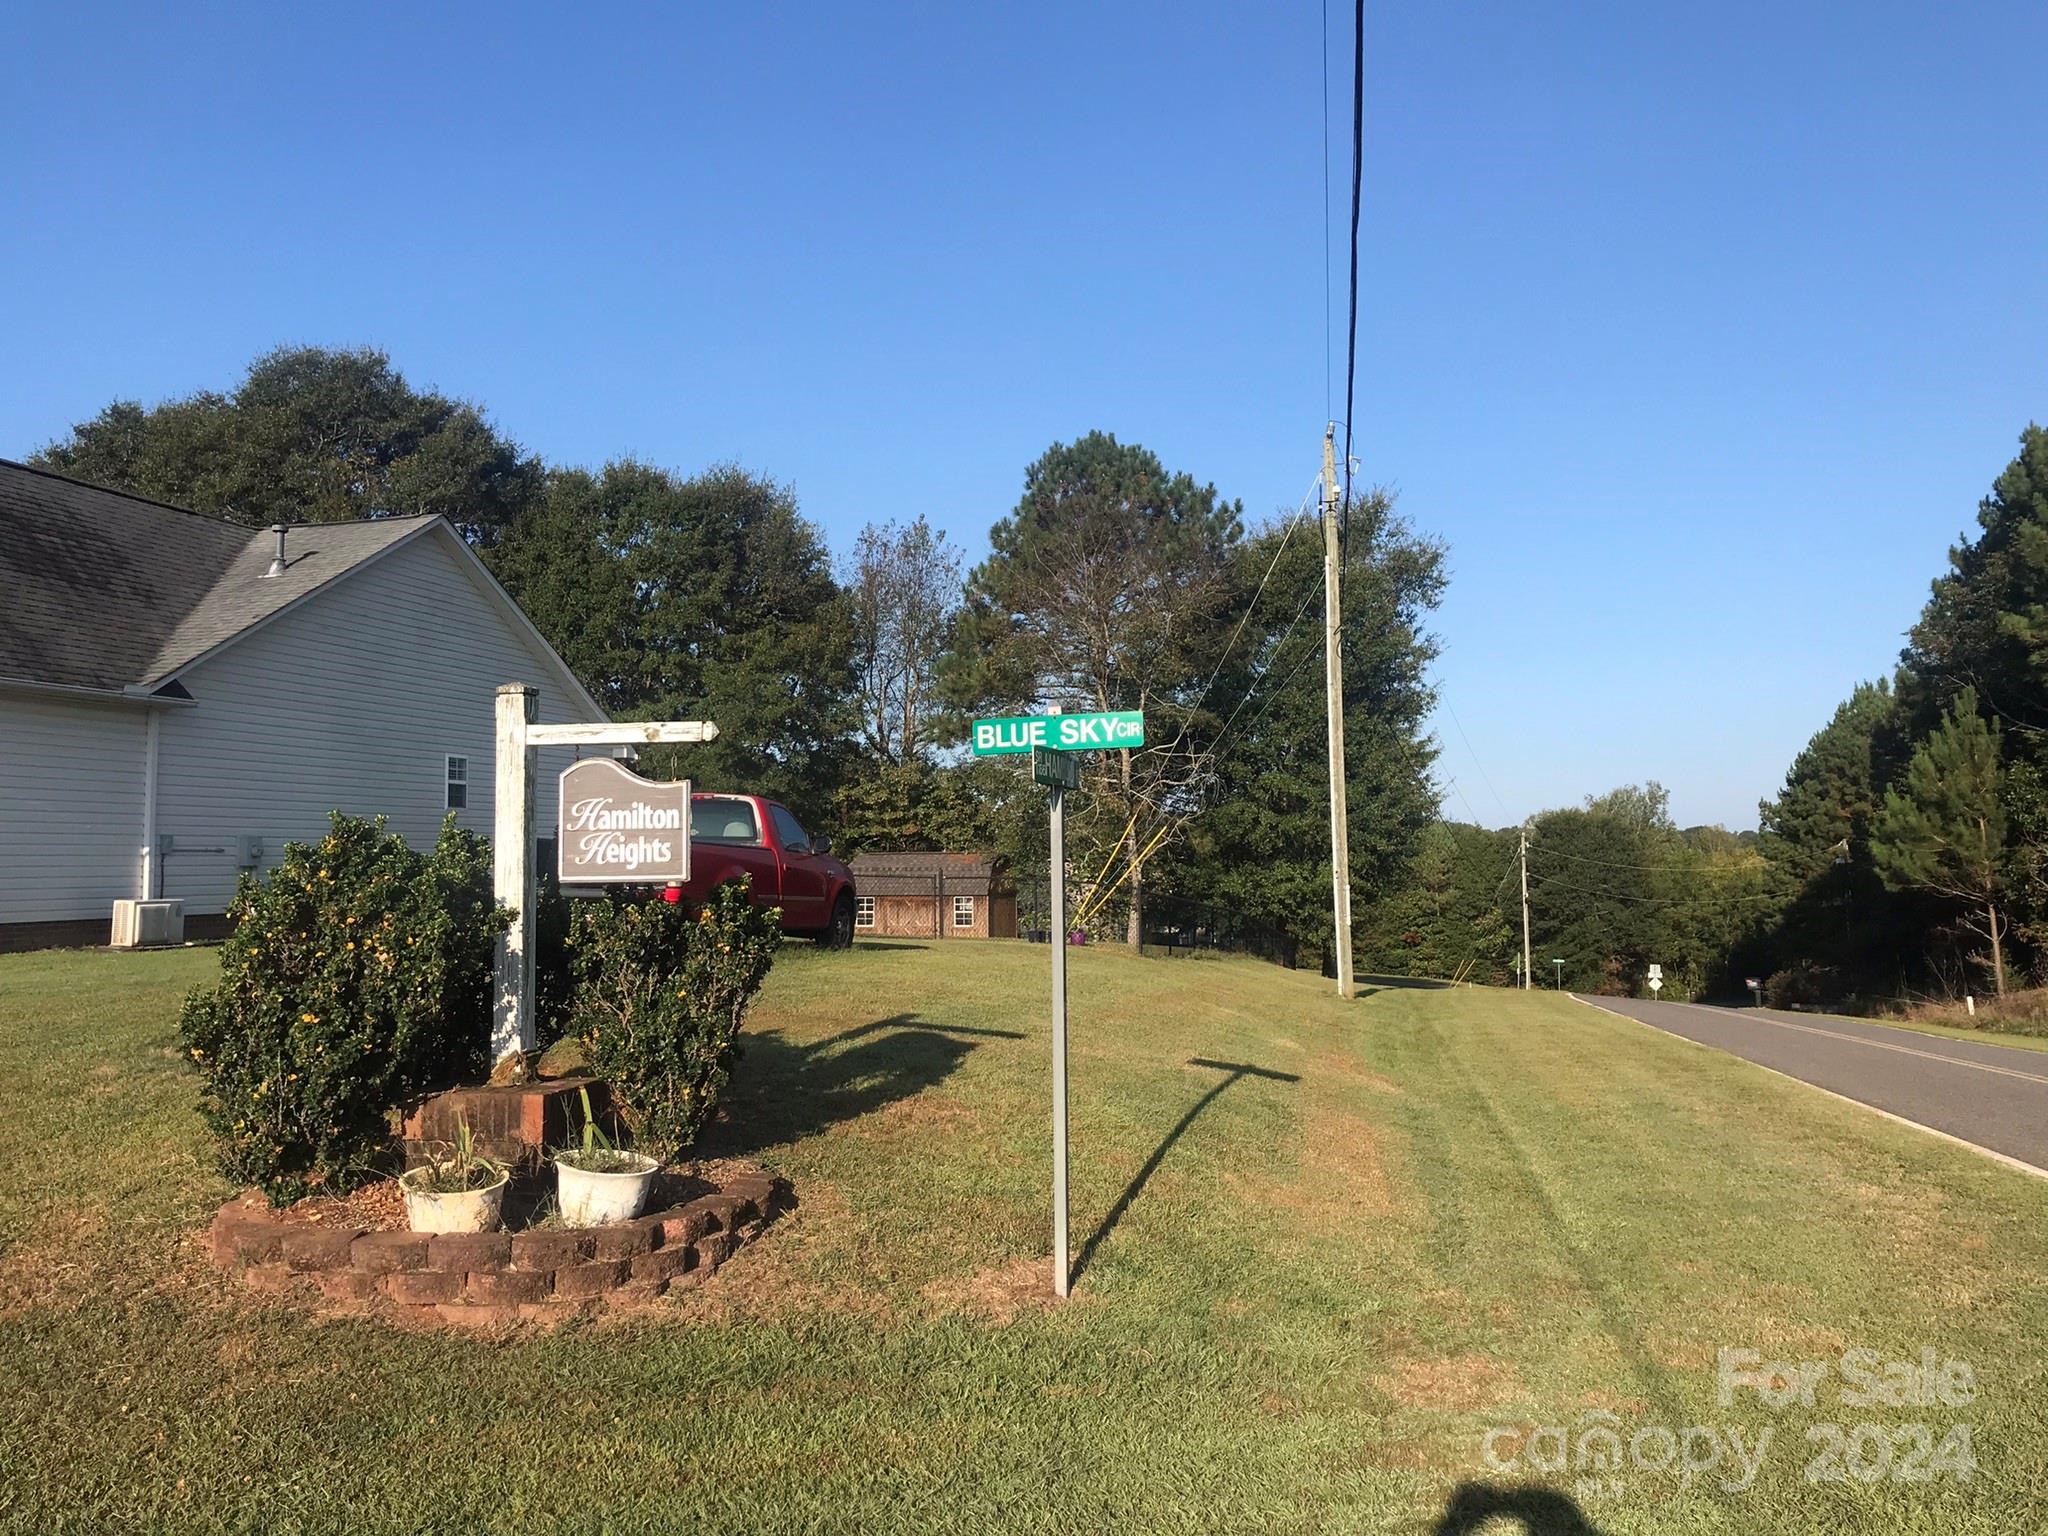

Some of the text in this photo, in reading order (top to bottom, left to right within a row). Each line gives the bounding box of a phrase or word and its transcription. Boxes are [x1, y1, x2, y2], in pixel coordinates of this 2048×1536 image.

[977, 717, 1140, 748] BLUE SKY CIR
[567, 798, 680, 831] Hamilton
[575, 831, 672, 870] Heights
